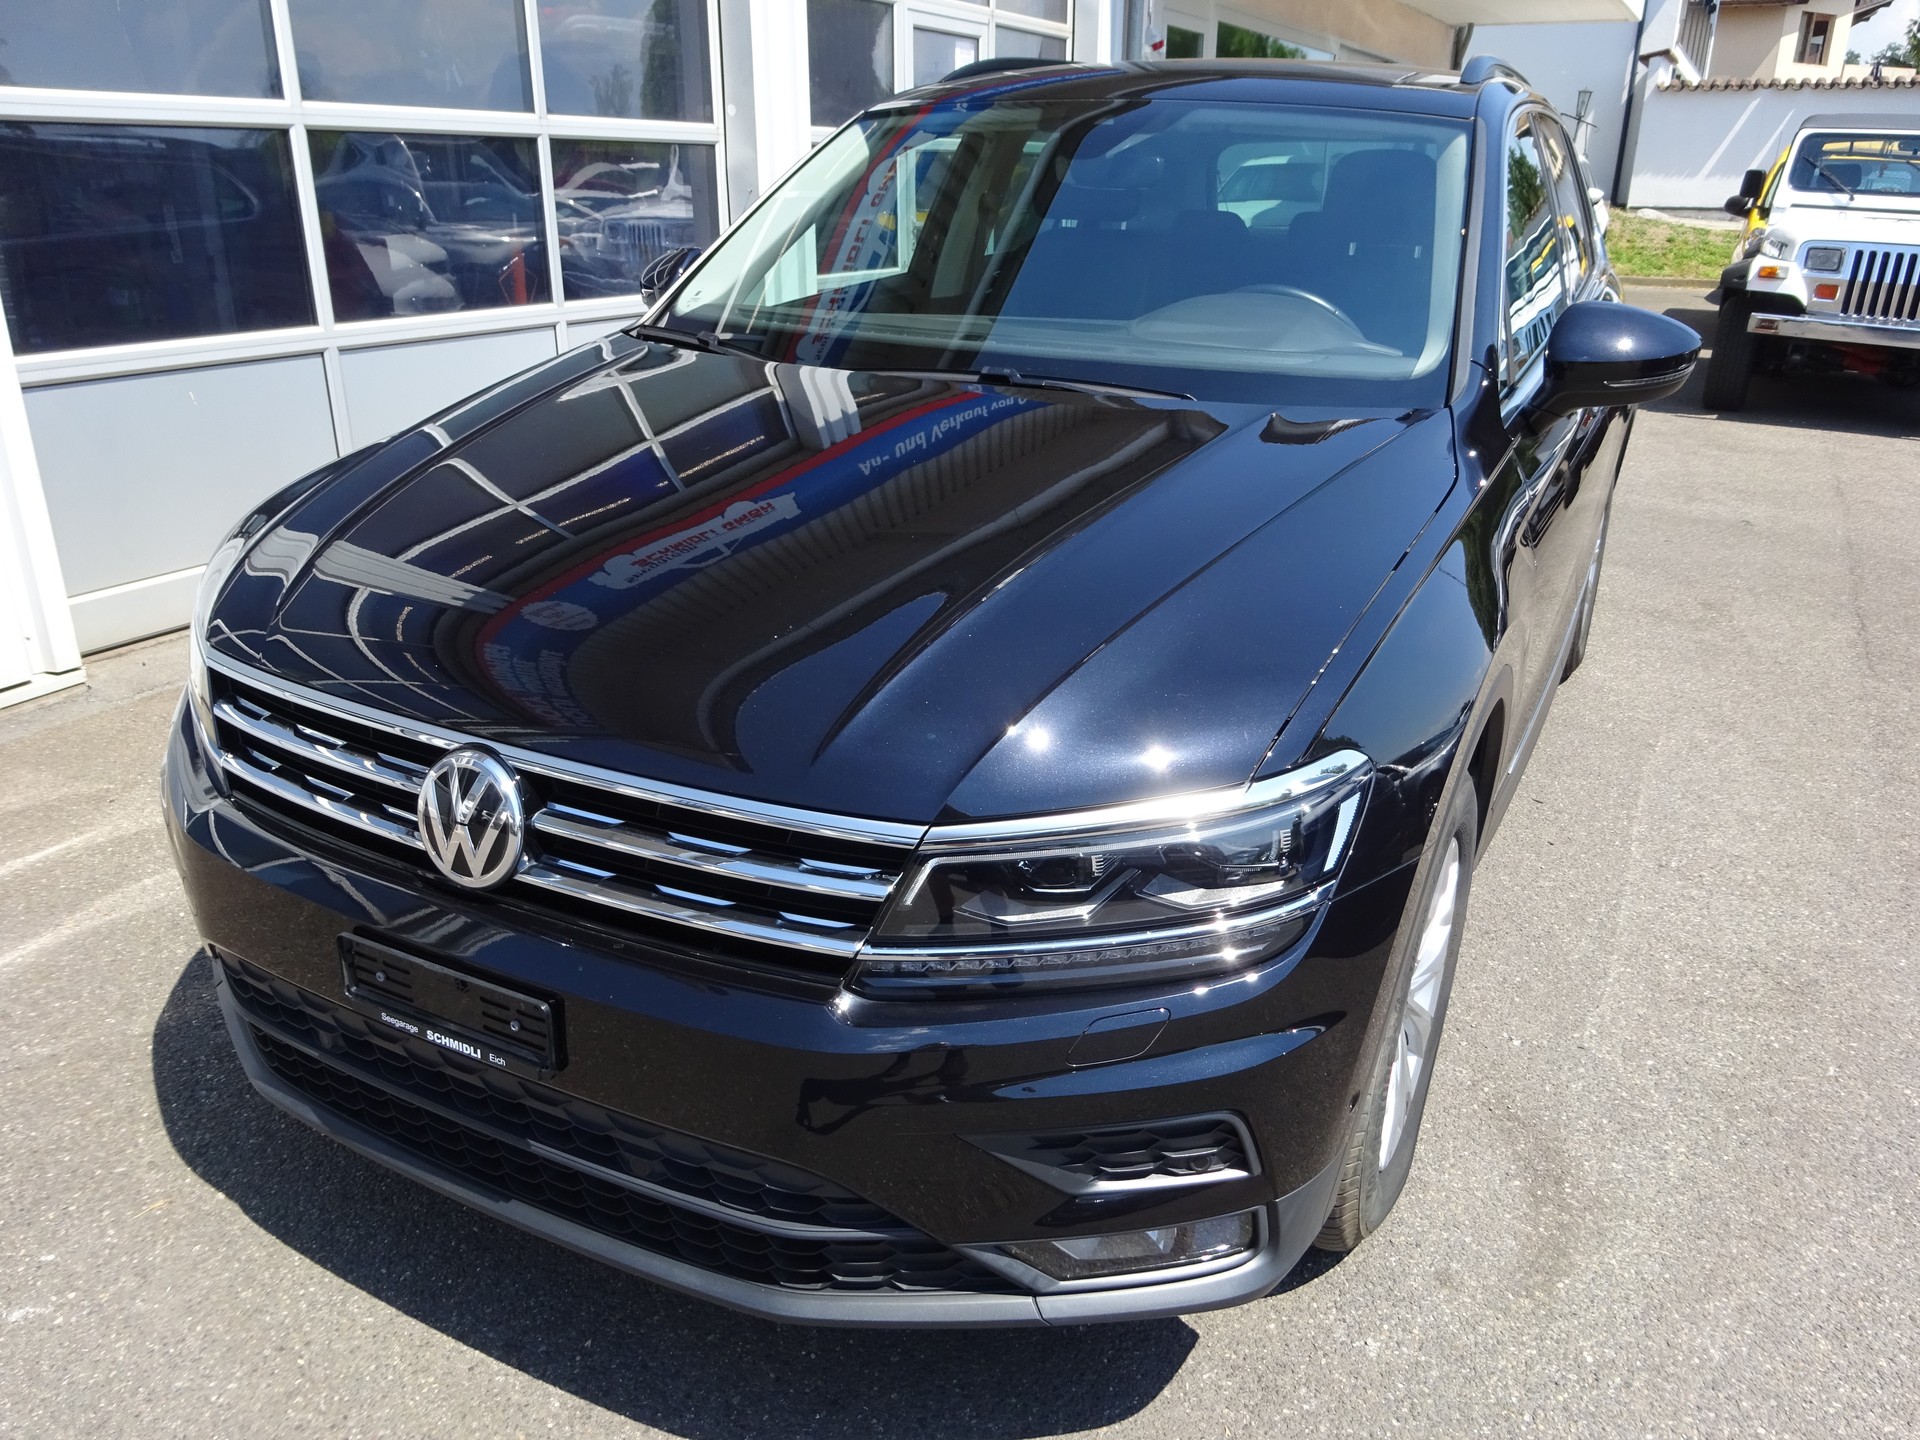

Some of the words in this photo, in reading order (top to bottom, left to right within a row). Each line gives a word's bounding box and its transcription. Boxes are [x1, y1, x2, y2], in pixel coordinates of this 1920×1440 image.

[418, 750, 524, 888] VW
[381, 1012, 419, 1034] Seegarage
[426, 1029, 481, 1059] SCHMIDLI
[488, 1053, 506, 1067] Eich
